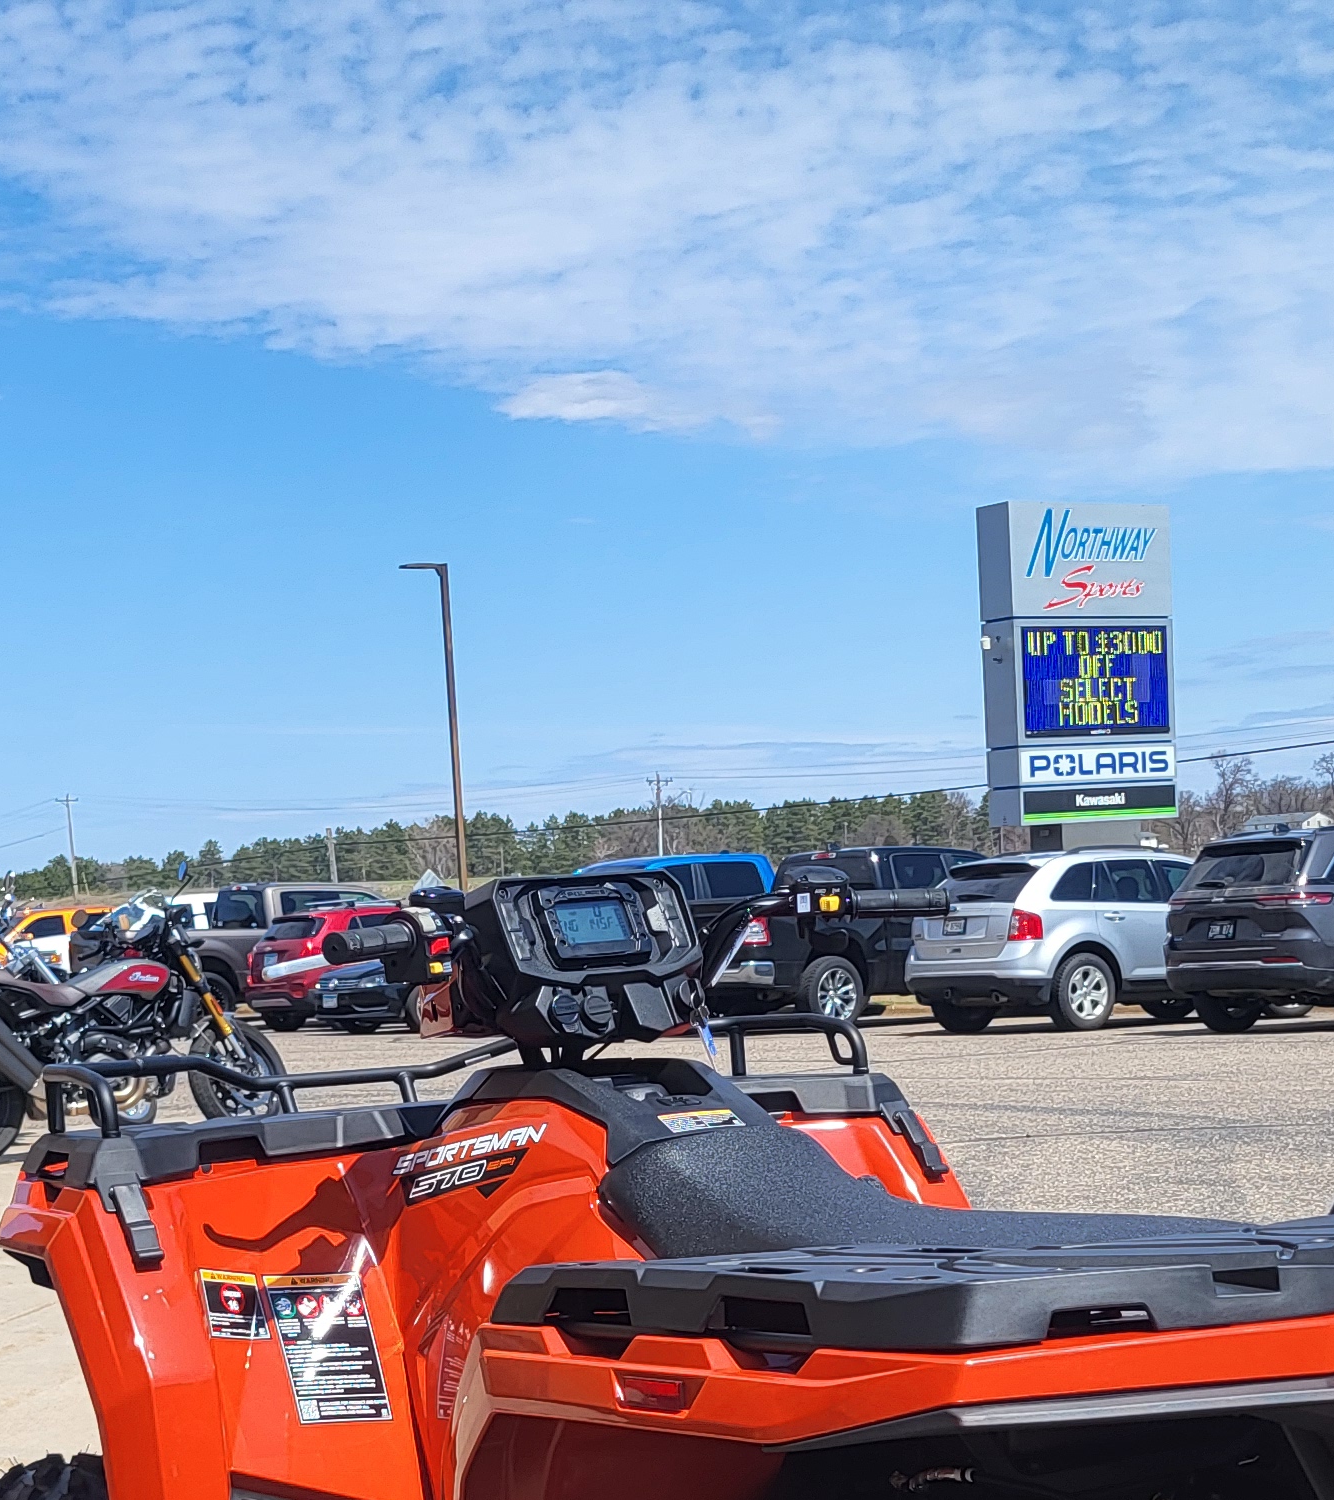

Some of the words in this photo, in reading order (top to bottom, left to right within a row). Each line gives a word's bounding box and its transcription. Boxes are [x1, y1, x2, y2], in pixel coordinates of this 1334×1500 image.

[1025, 508, 1157, 578] NORTHWAY
[1043, 564, 1144, 610] Sports
[1027, 631, 1057, 655] UP
[1062, 631, 1089, 655] TO
[1096, 630, 1162, 655] $3000
[1079, 654, 1116, 679] OFF
[1060, 677, 1137, 702] SELECT
[1059, 700, 1138, 726] MODELS
[1029, 751, 1168, 778] POLARIS
[1075, 792, 1126, 807] Kawasaki
[392, 1122, 548, 1176] SPORTSMAN
[409, 1160, 487, 1199] 570
